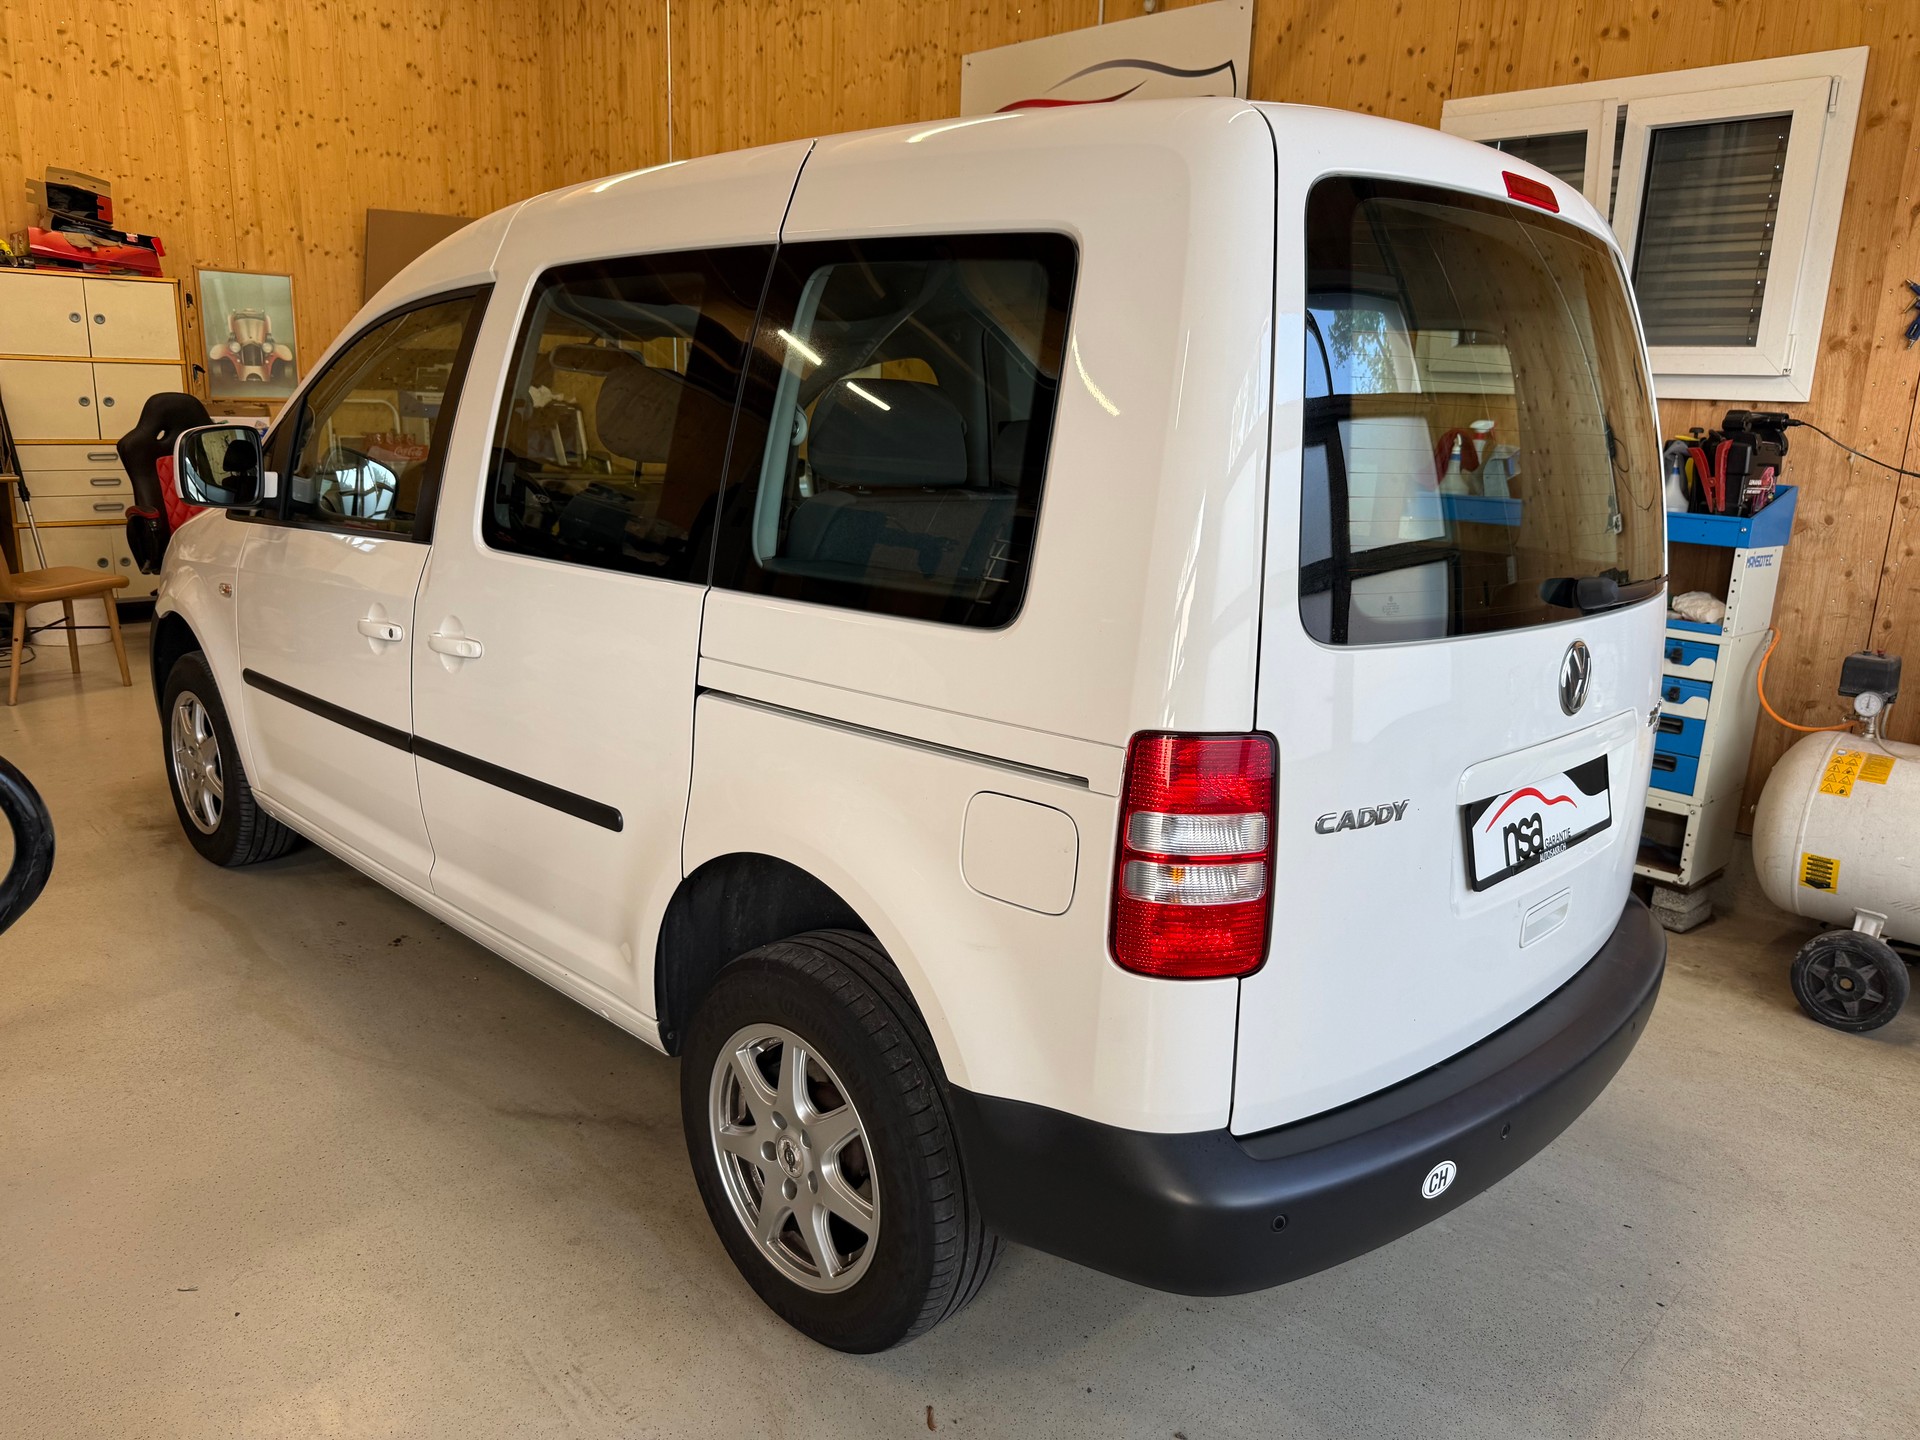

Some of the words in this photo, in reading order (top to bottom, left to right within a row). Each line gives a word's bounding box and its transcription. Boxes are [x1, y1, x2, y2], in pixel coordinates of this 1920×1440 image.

[1314, 798, 1410, 835] CADDY
[1502, 812, 1545, 868] nsa
[1544, 827, 1572, 849] GARANTIE
[1429, 1167, 1449, 1194] CH
